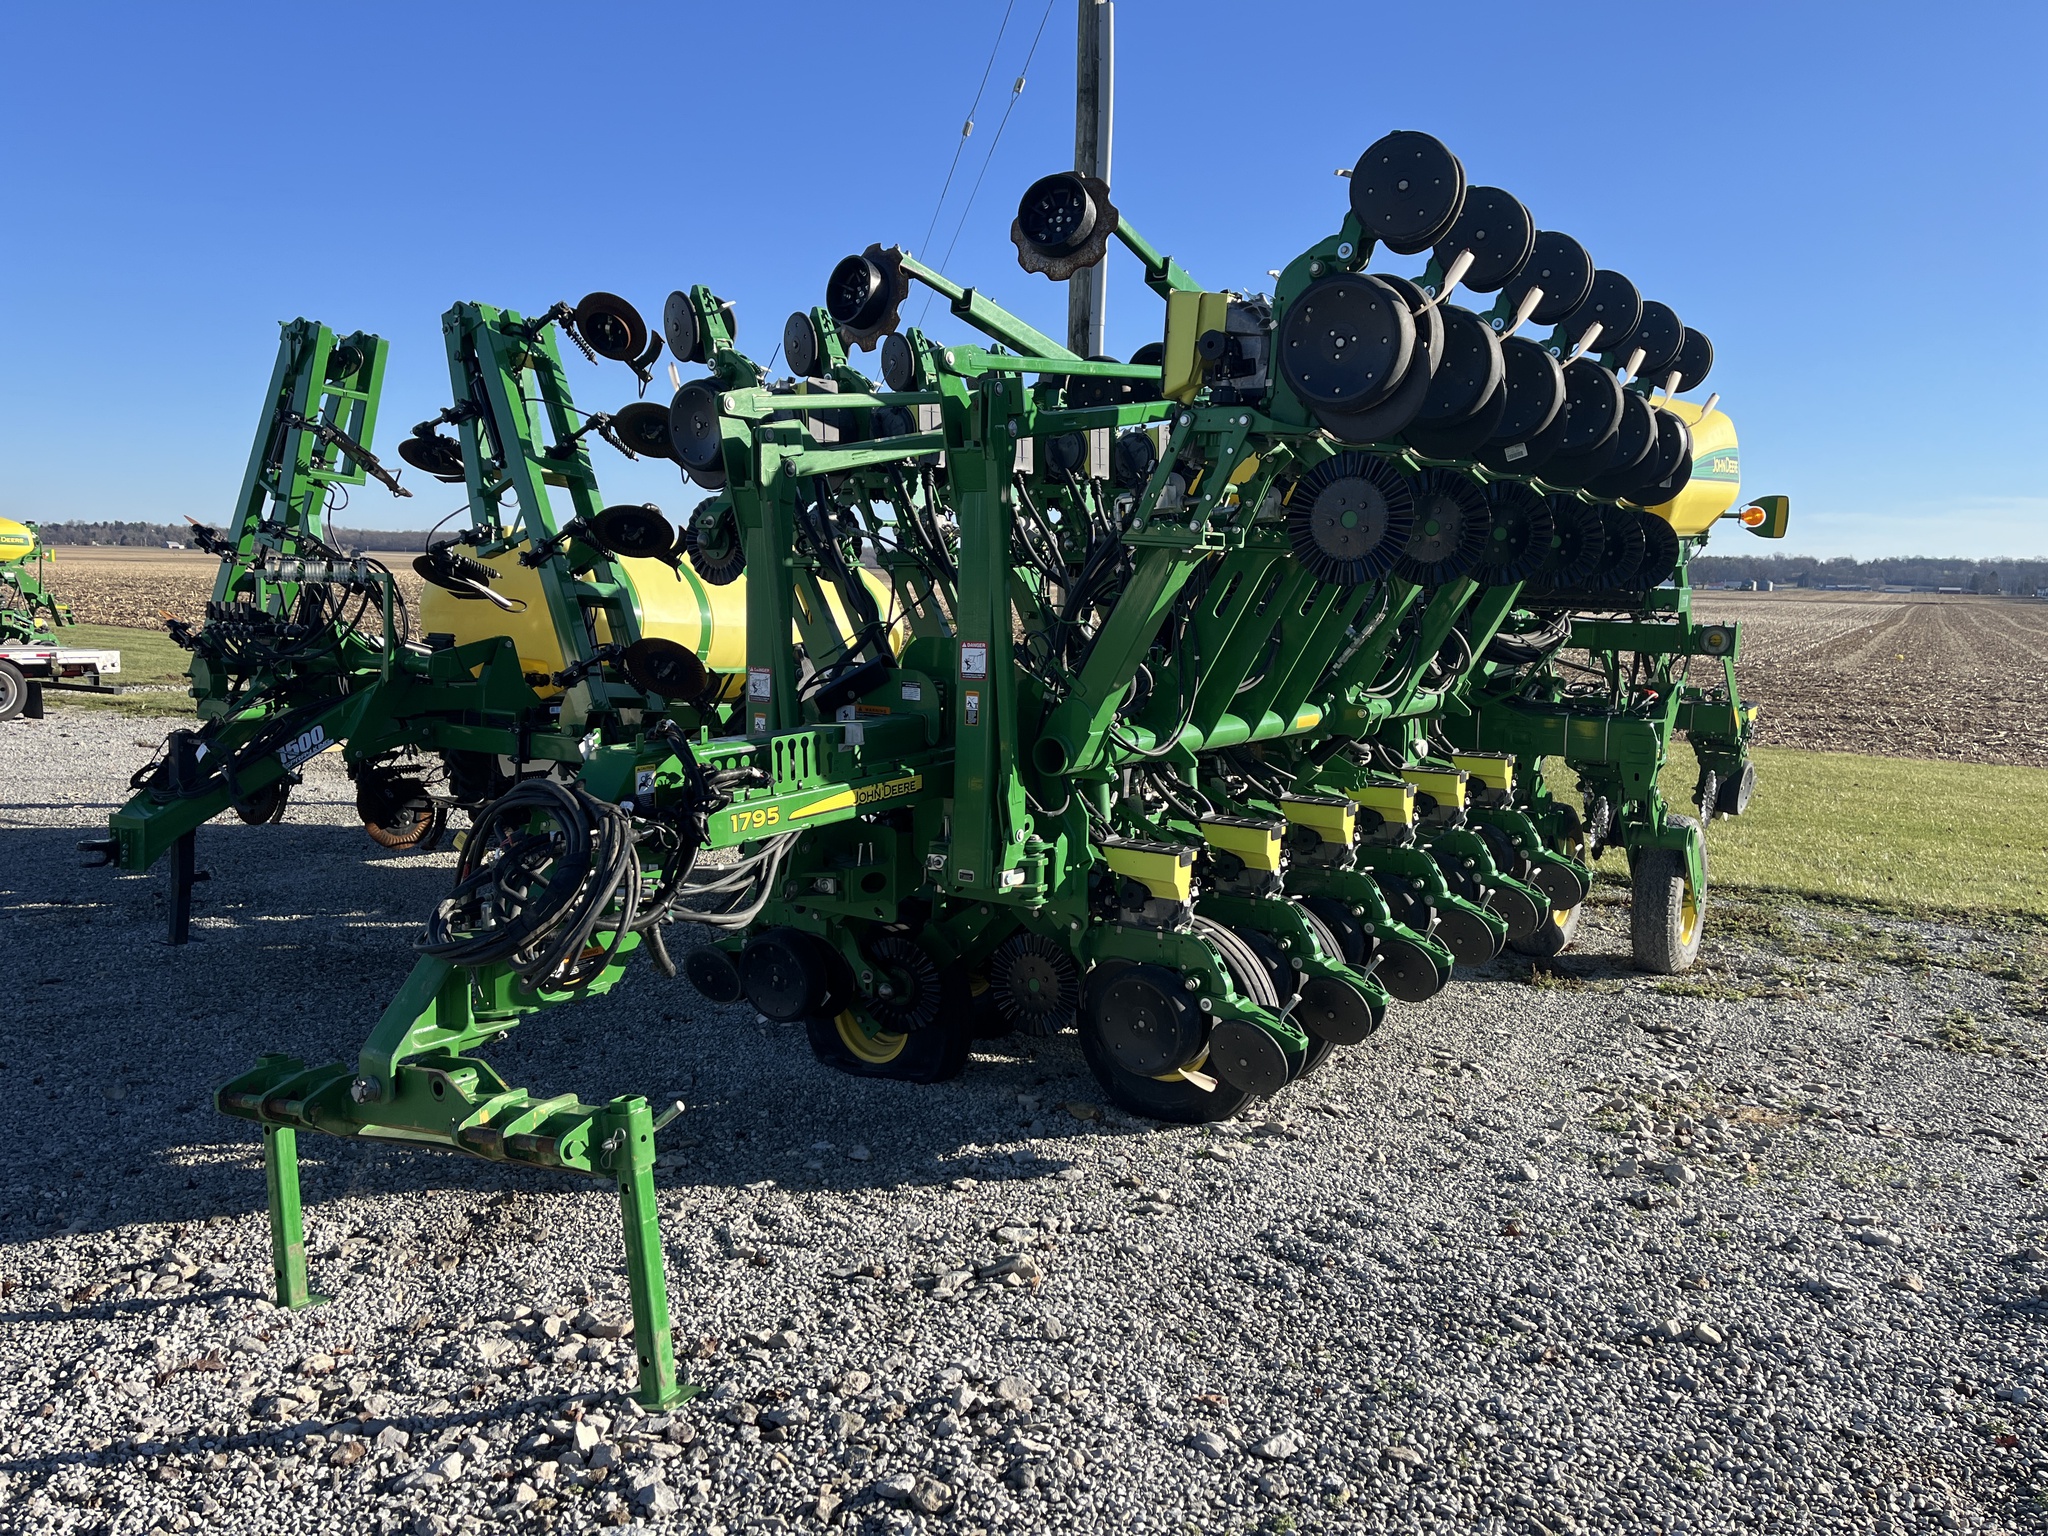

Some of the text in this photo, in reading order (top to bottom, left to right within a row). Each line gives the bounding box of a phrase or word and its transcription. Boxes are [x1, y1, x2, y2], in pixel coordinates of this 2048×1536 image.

[1713, 456, 1725, 473] JOHN
[276, 725, 324, 763] 1500
[854, 780, 916, 804] JOHN DEERE
[730, 805, 780, 833] 1795
